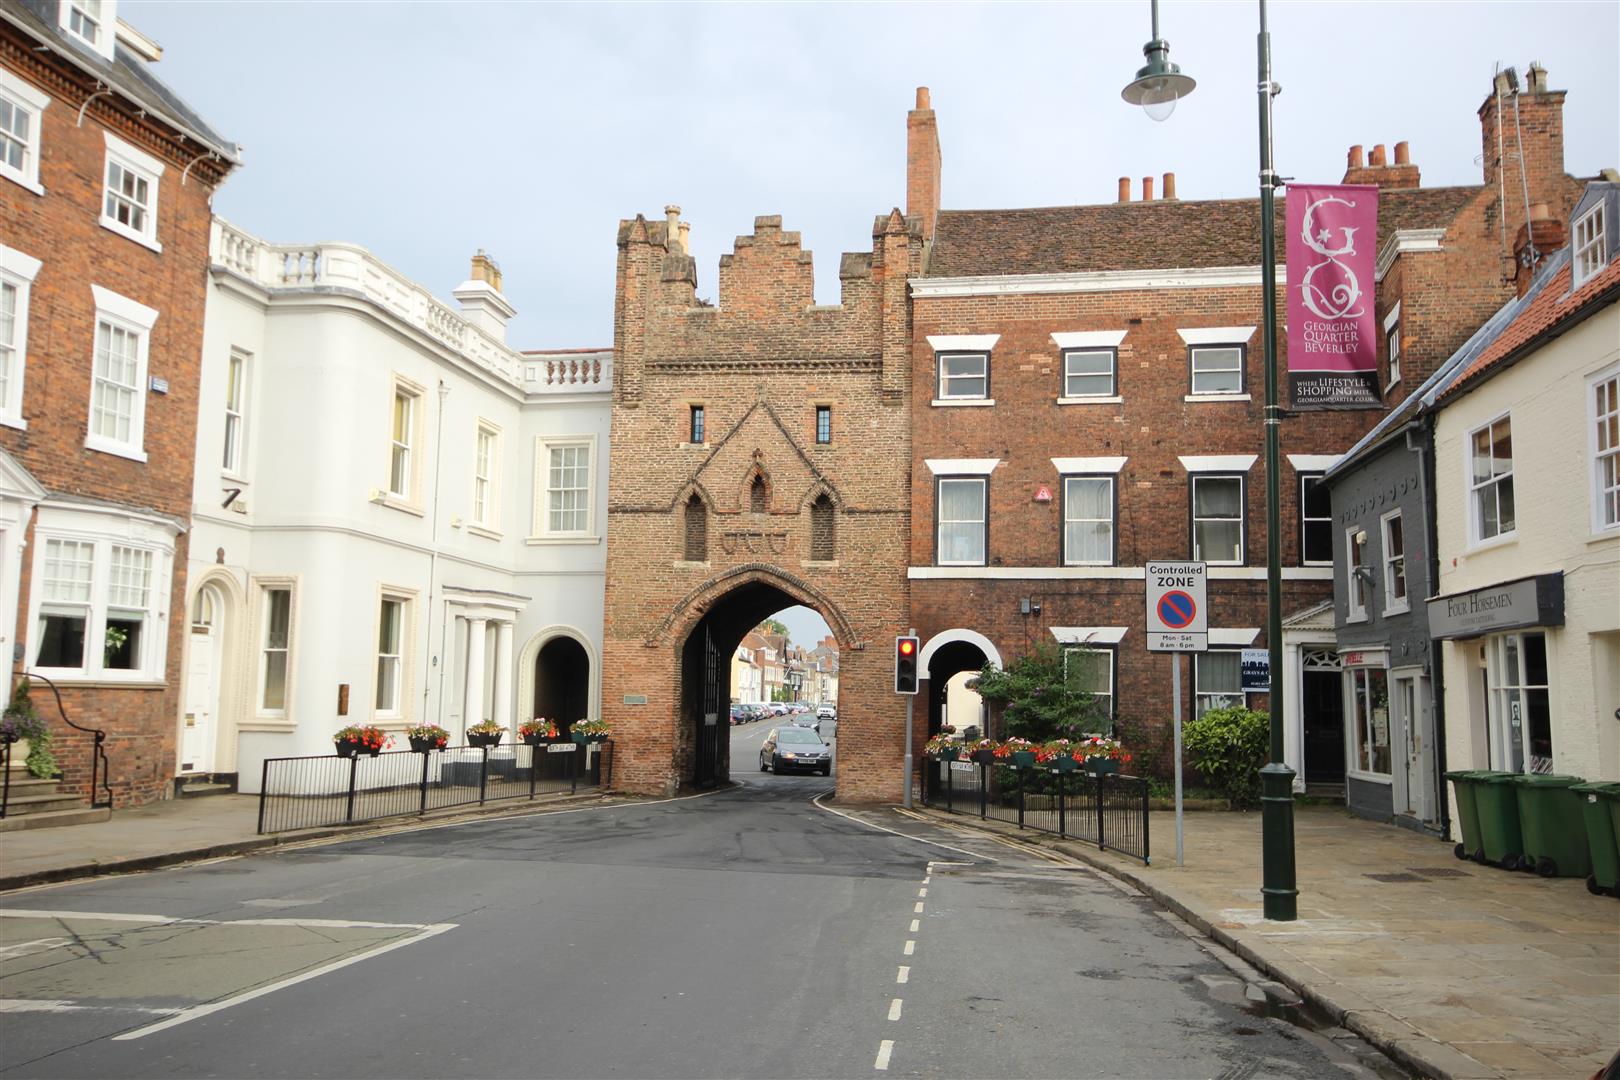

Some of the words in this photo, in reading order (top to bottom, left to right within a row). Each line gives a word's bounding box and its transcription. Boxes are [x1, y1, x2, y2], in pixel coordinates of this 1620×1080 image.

[1303, 321, 1358, 332] GEORGIAN
[1303, 331, 1359, 344] QUARTER
[1304, 343, 1359, 353] BEVERLEY
[1319, 378, 1365, 387] LIFESTYLE
[1297, 386, 1352, 396] SHOPPING
[1149, 566, 1203, 574] Controlled
[1157, 577, 1194, 587] ZONE
[1447, 599, 1468, 618] FOUR
[1469, 592, 1512, 614] HORSEMEN
